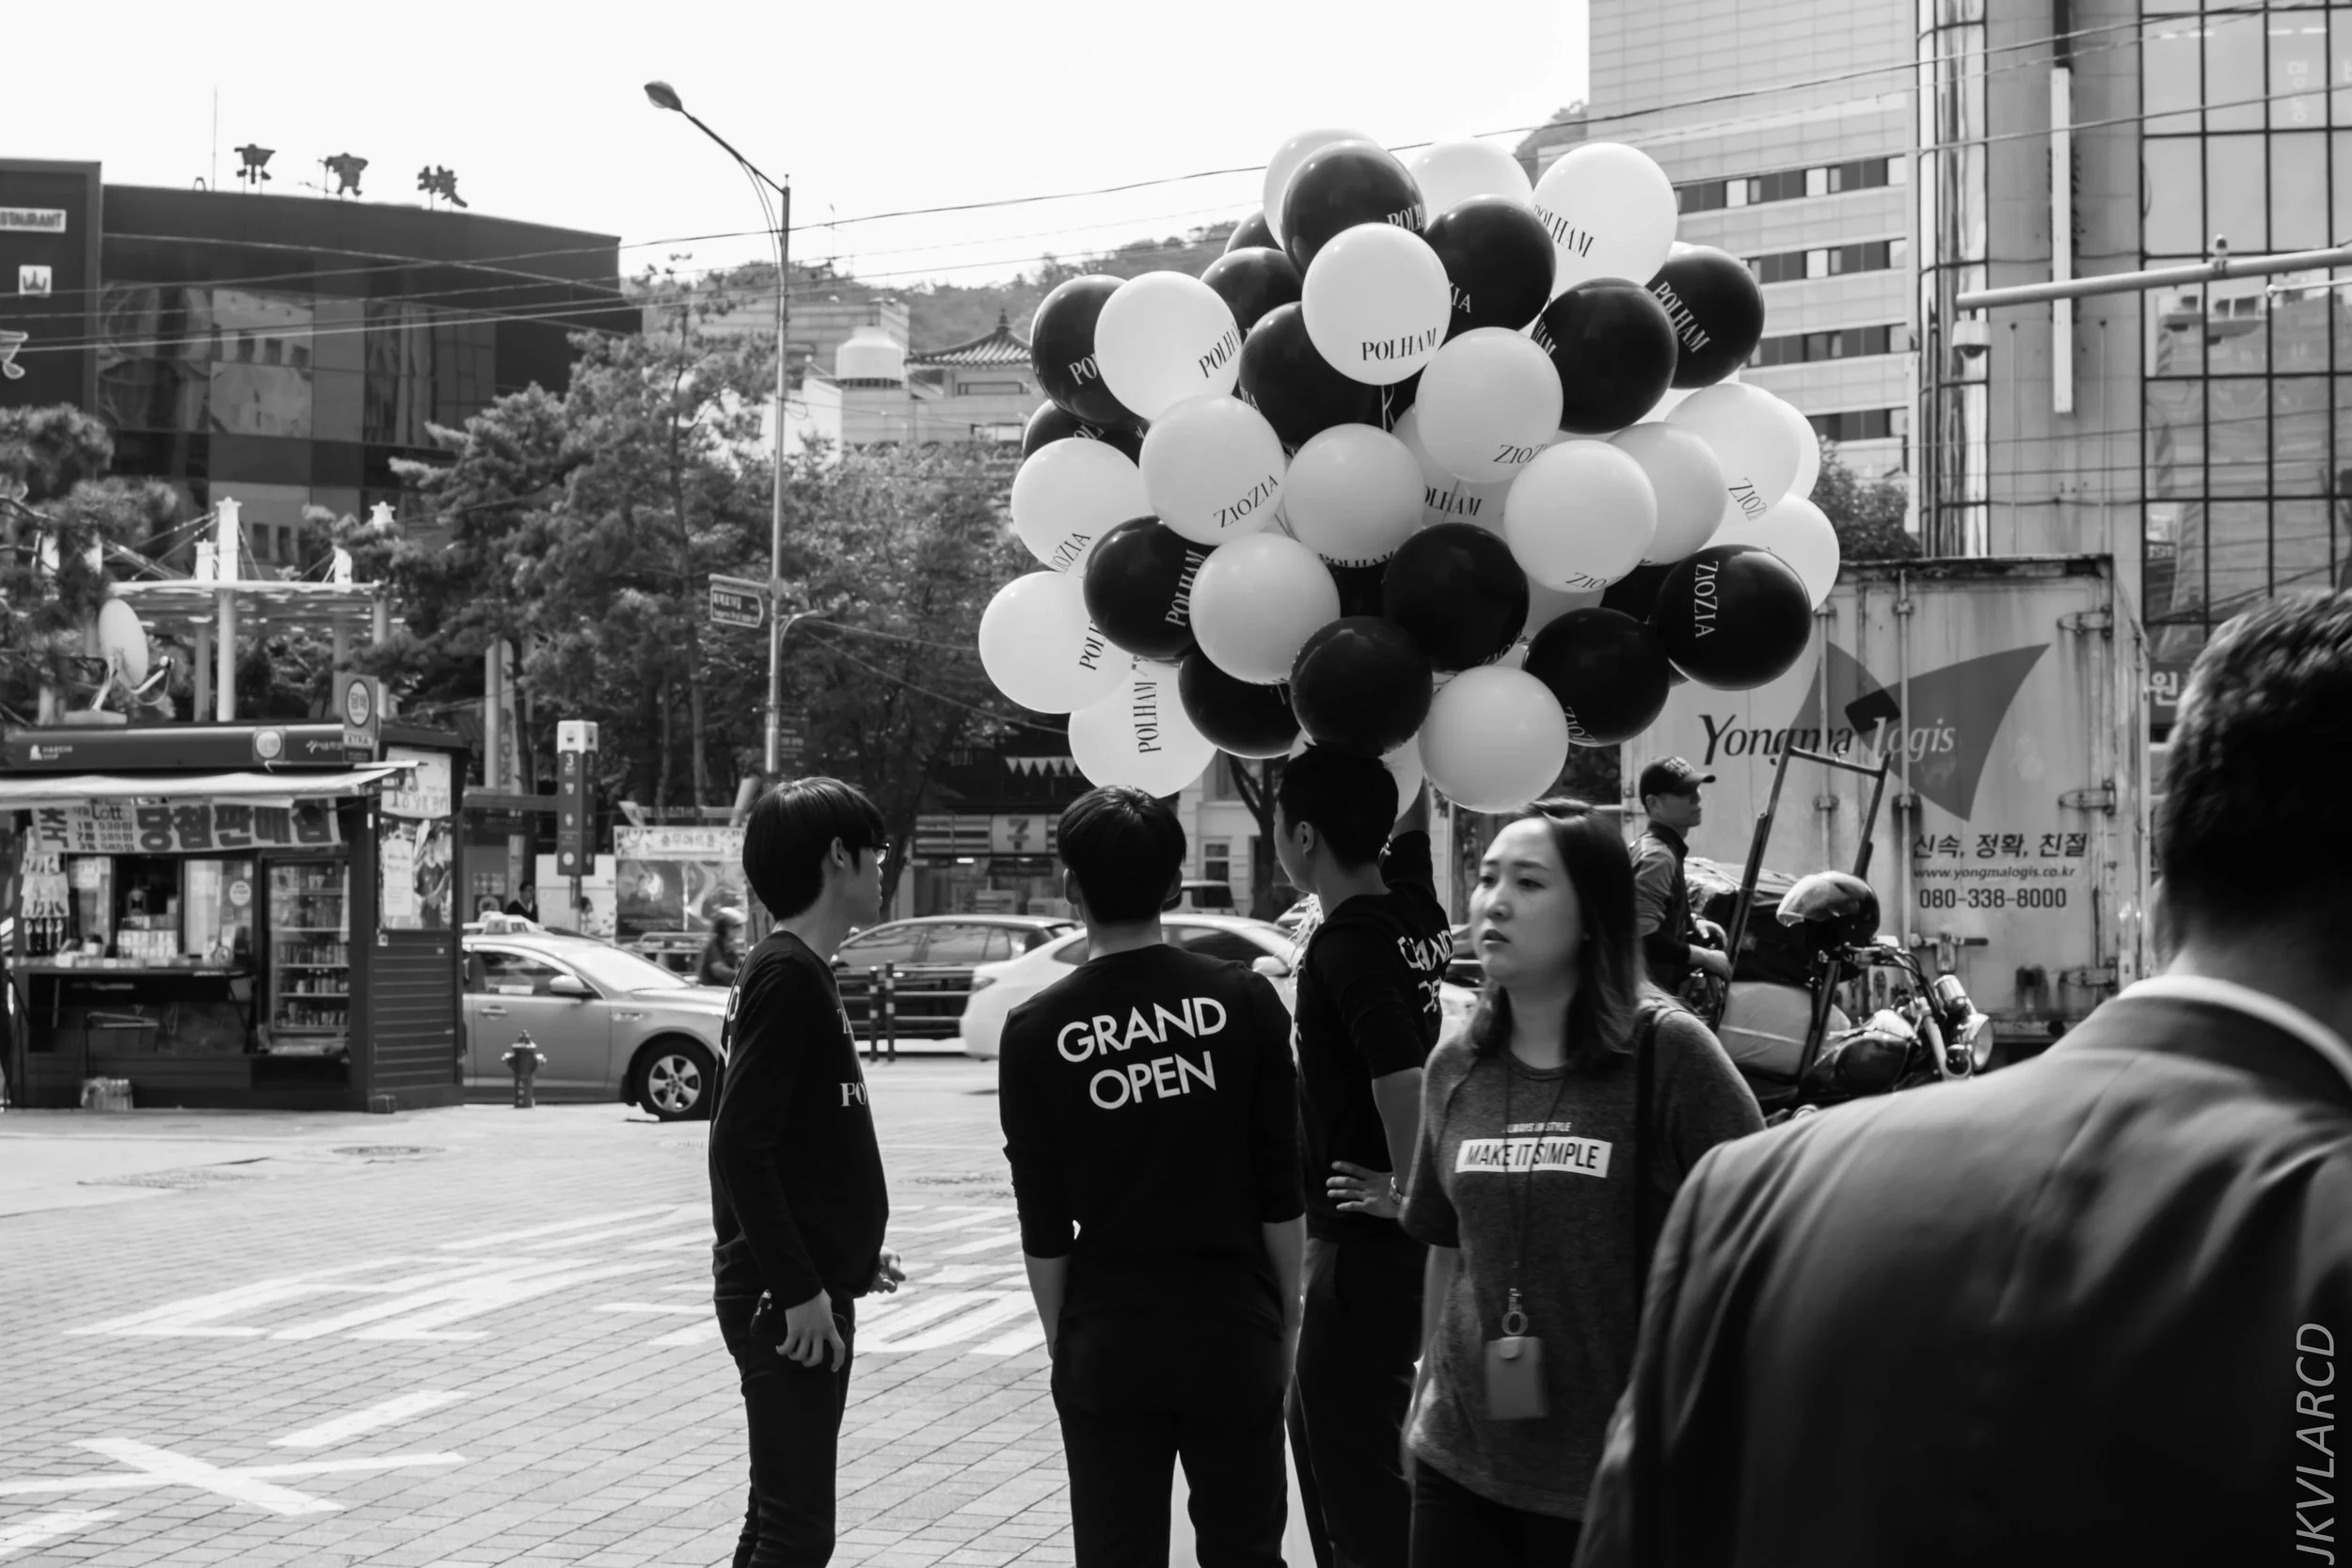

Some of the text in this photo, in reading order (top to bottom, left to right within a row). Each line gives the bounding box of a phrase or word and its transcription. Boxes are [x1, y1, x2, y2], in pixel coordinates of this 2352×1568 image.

[1450, 282, 1471, 314] IA
[1653, 280, 1711, 354] POLHAM
[1361, 327, 1437, 361] POLHAM
[1069, 353, 1101, 386] PO
[1213, 474, 1279, 529] ZIOZIA
[1693, 560, 1719, 639] ZIOZIA
[1133, 682, 1162, 754] POLHAM
[1699, 714, 1852, 766] Yongma
[1914, 833, 2087, 859] 신속, 정확, 친절
[1914, 866, 2075, 880] www.yongmalogis.co.kr
[1919, 888, 2066, 909] 080-338-8000
[1057, 997, 1227, 1063] GRAND
[839, 1082, 866, 1107] PO
[1089, 1051, 1216, 1110] OPEN
[1464, 1142, 1600, 1169] MAKE IT SIMPLE
